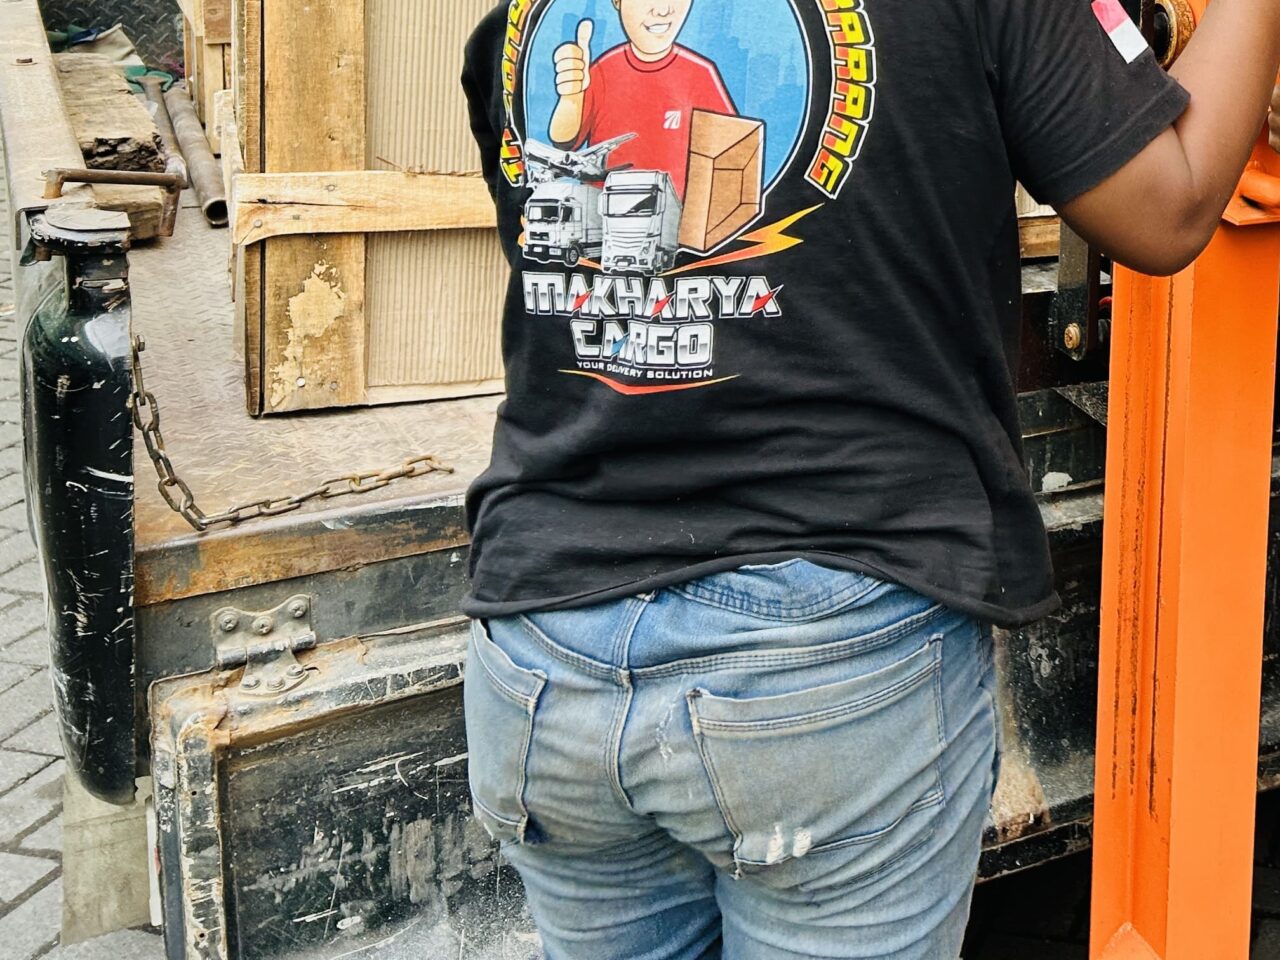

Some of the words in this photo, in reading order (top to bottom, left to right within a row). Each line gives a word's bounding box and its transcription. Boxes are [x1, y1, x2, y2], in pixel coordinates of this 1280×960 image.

[522, 271, 784, 323] MAKHARYA
[570, 319, 714, 369] CARGO
[577, 361, 604, 371] YOUR
[606, 364, 643, 378] DELIVERY
[646, 368, 713, 379] SOLUTION
